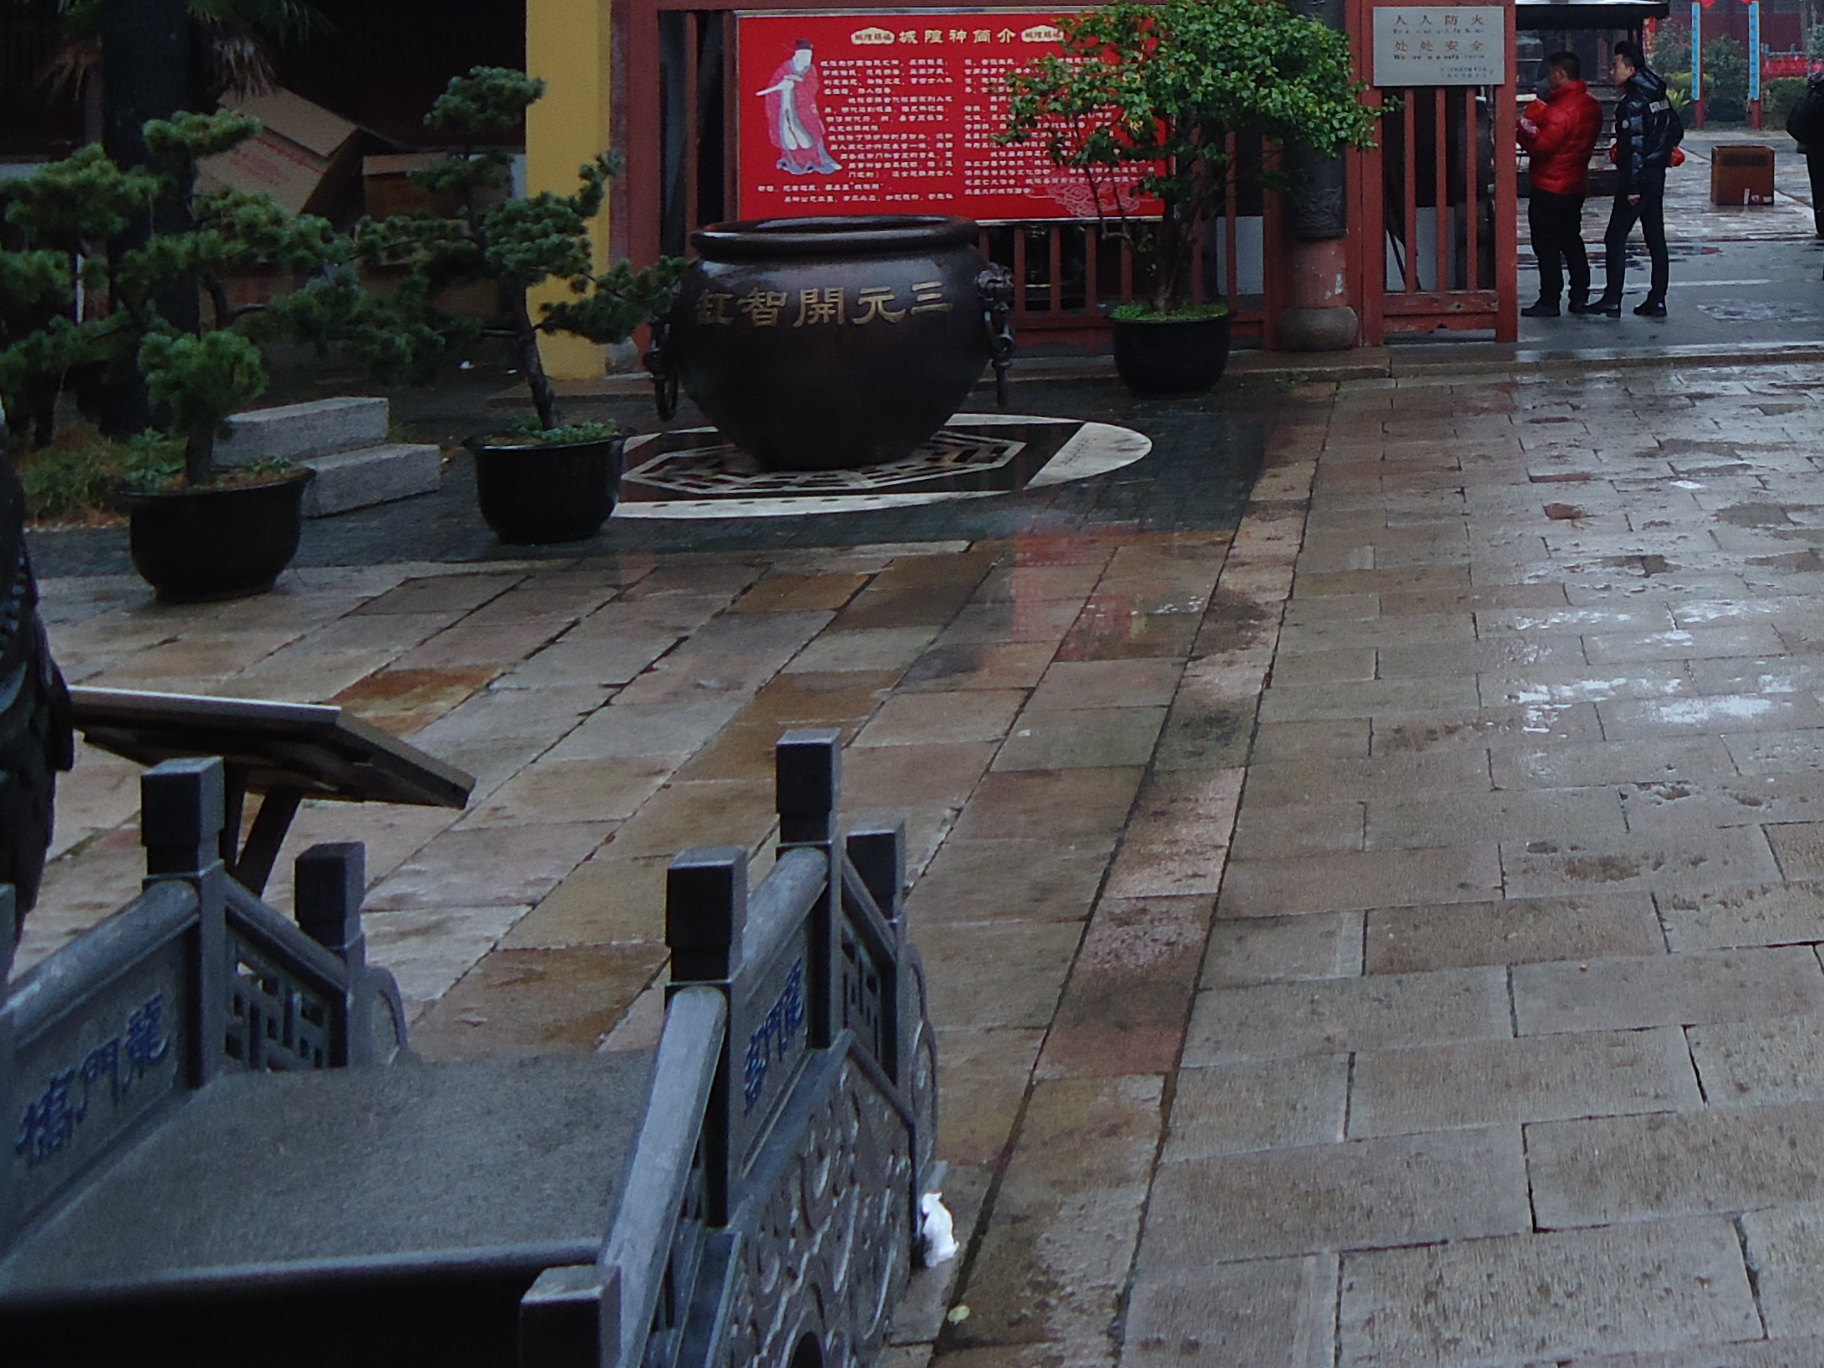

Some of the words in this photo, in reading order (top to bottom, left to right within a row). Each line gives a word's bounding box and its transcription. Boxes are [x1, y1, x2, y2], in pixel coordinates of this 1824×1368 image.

[1395, 14, 1484, 26] 人人防火
[899, 28, 1016, 45] 城隍神简介
[1394, 39, 1484, 52] 处处安全
